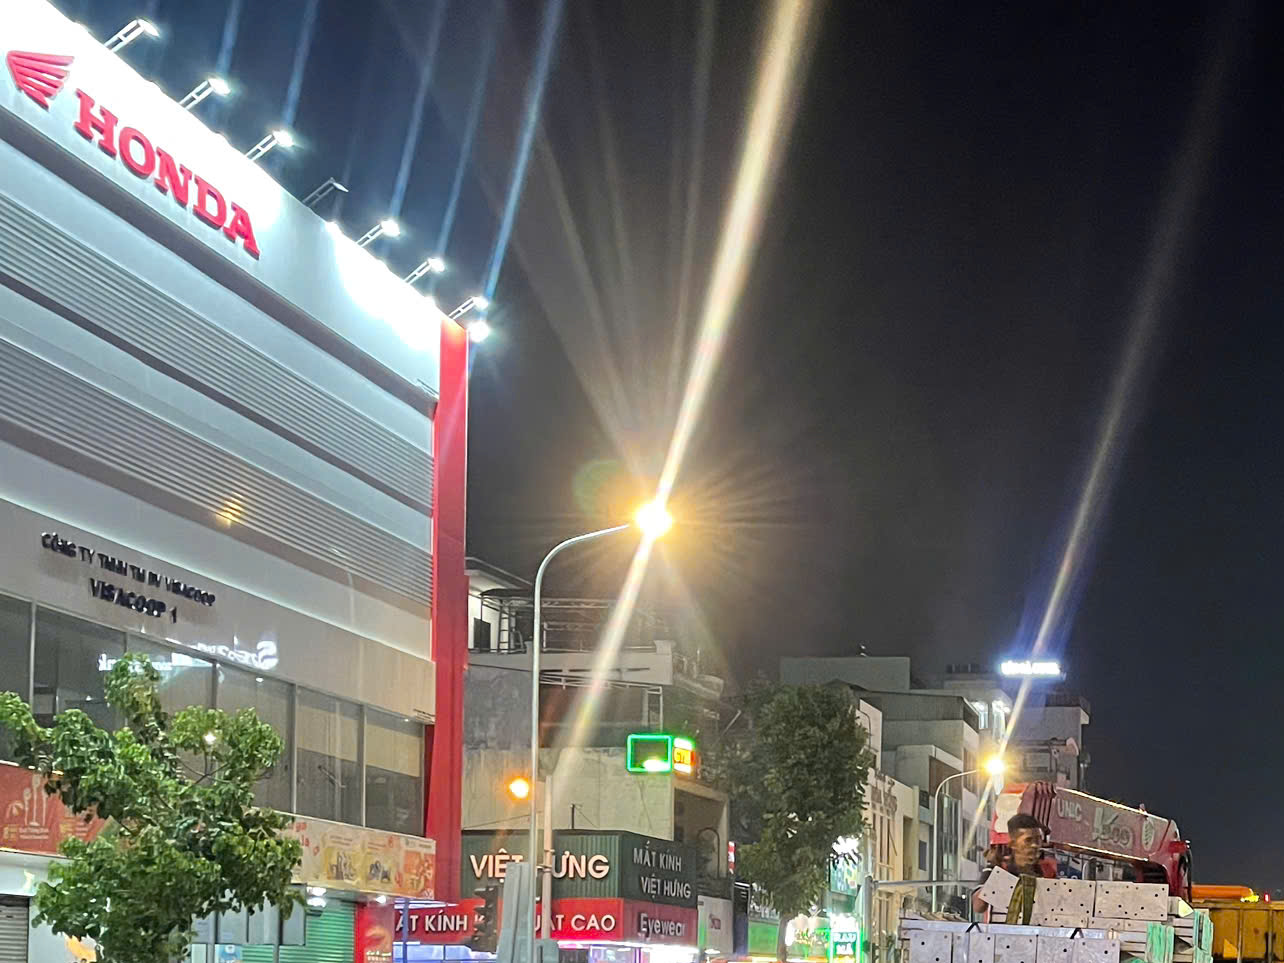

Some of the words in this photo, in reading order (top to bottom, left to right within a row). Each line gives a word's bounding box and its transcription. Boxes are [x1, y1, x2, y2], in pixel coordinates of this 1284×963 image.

[73, 88, 260, 260] HONDA
[78, 546, 95, 564] TY
[169, 606, 177, 624] 1
[470, 848, 524, 884] VIỆ
[552, 851, 610, 879] ƯNG
[659, 849, 682, 872] KÍNH
[641, 873, 661, 898] VIỆT
[425, 909, 468, 931] KÍNH
[571, 913, 616, 932] CAO
[640, 912, 686, 940] Eyewear
